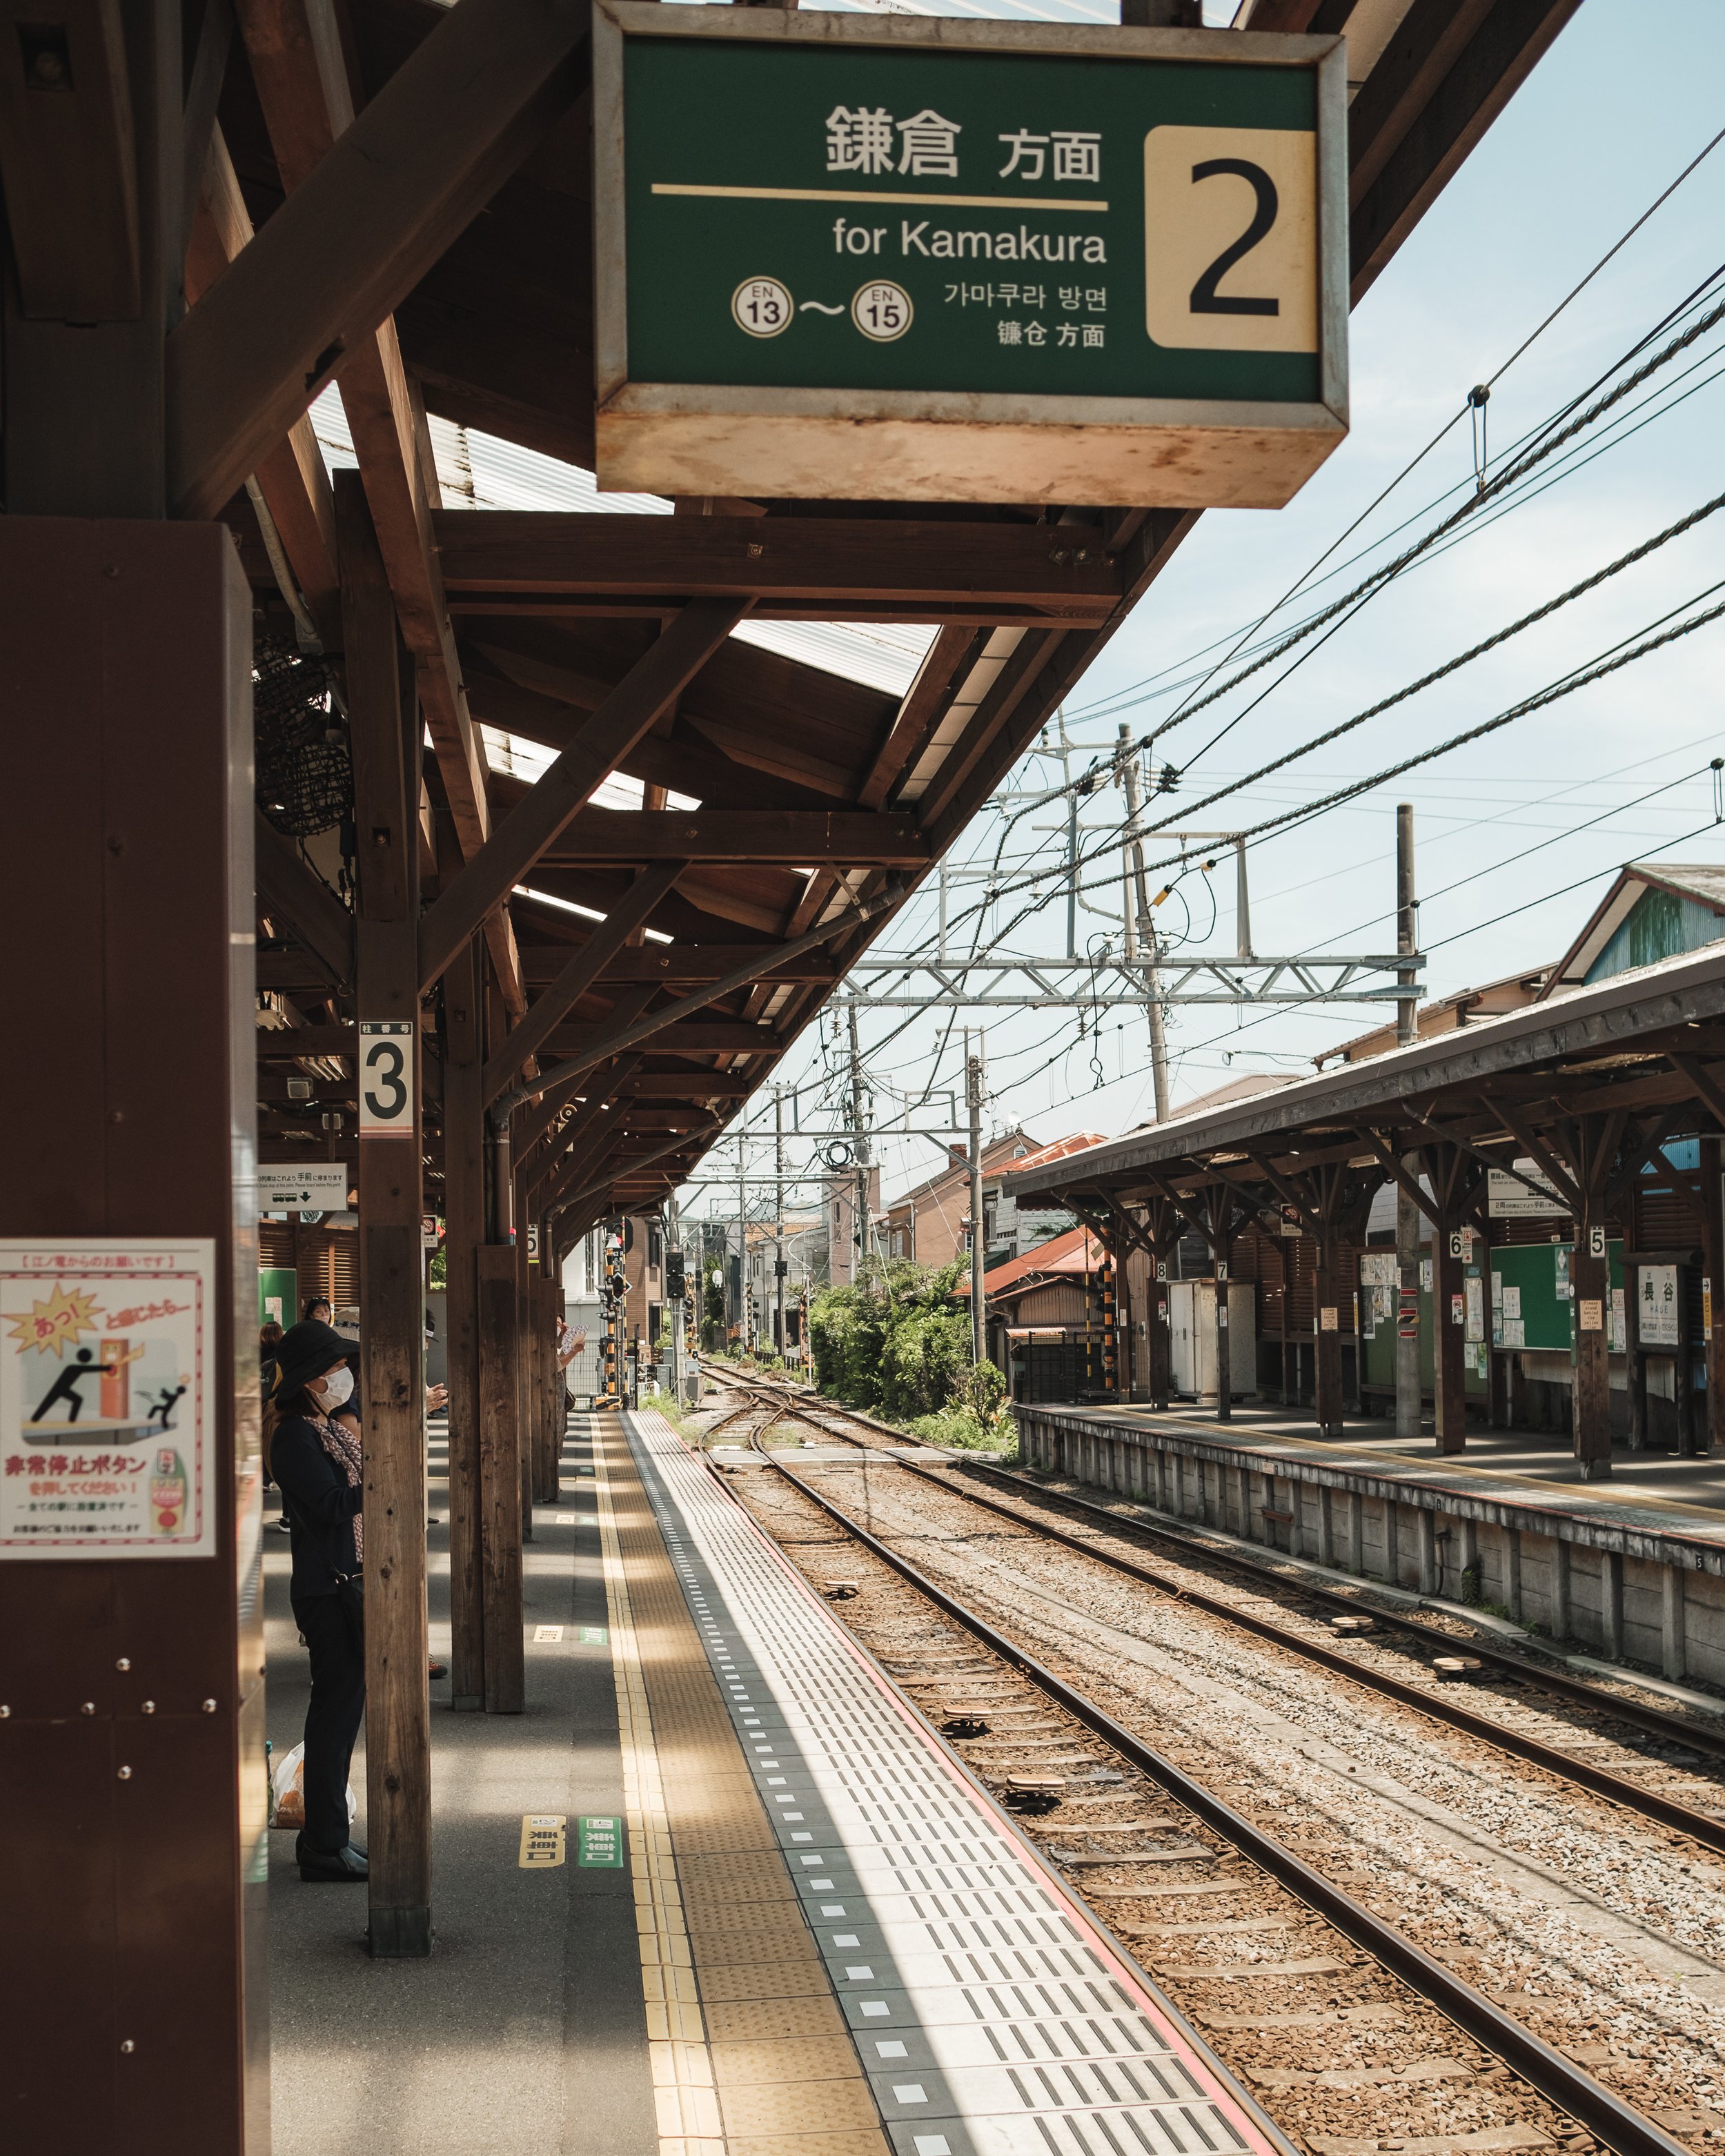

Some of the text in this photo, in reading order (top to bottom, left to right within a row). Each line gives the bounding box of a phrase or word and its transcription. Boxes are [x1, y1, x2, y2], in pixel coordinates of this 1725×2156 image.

[825, 106, 1102, 182] 鎌倉 方面
[832, 218, 1107, 264] for Kamakura
[1190, 158, 1279, 317] 2
[752, 286, 773, 298] EN
[871, 289, 893, 301] EN
[945, 282, 1107, 312] 가마쿠라 방면
[747, 301, 781, 324] 13
[867, 304, 900, 328] 15
[997, 320, 1105, 348] 镰仓 方面
[364, 1041, 407, 1120] 3
[1451, 1235, 1461, 1255] 6
[1592, 1232, 1604, 1254] 5
[1159, 1264, 1165, 1277] 8
[1218, 1264, 1226, 1278] 7
[1644, 1282, 1674, 1302] 長谷
[1650, 1305, 1668, 1314] HASE
[5, 1454, 147, 1476] 非常停止ボタン
[1697, 1557, 1702, 1568] 5
